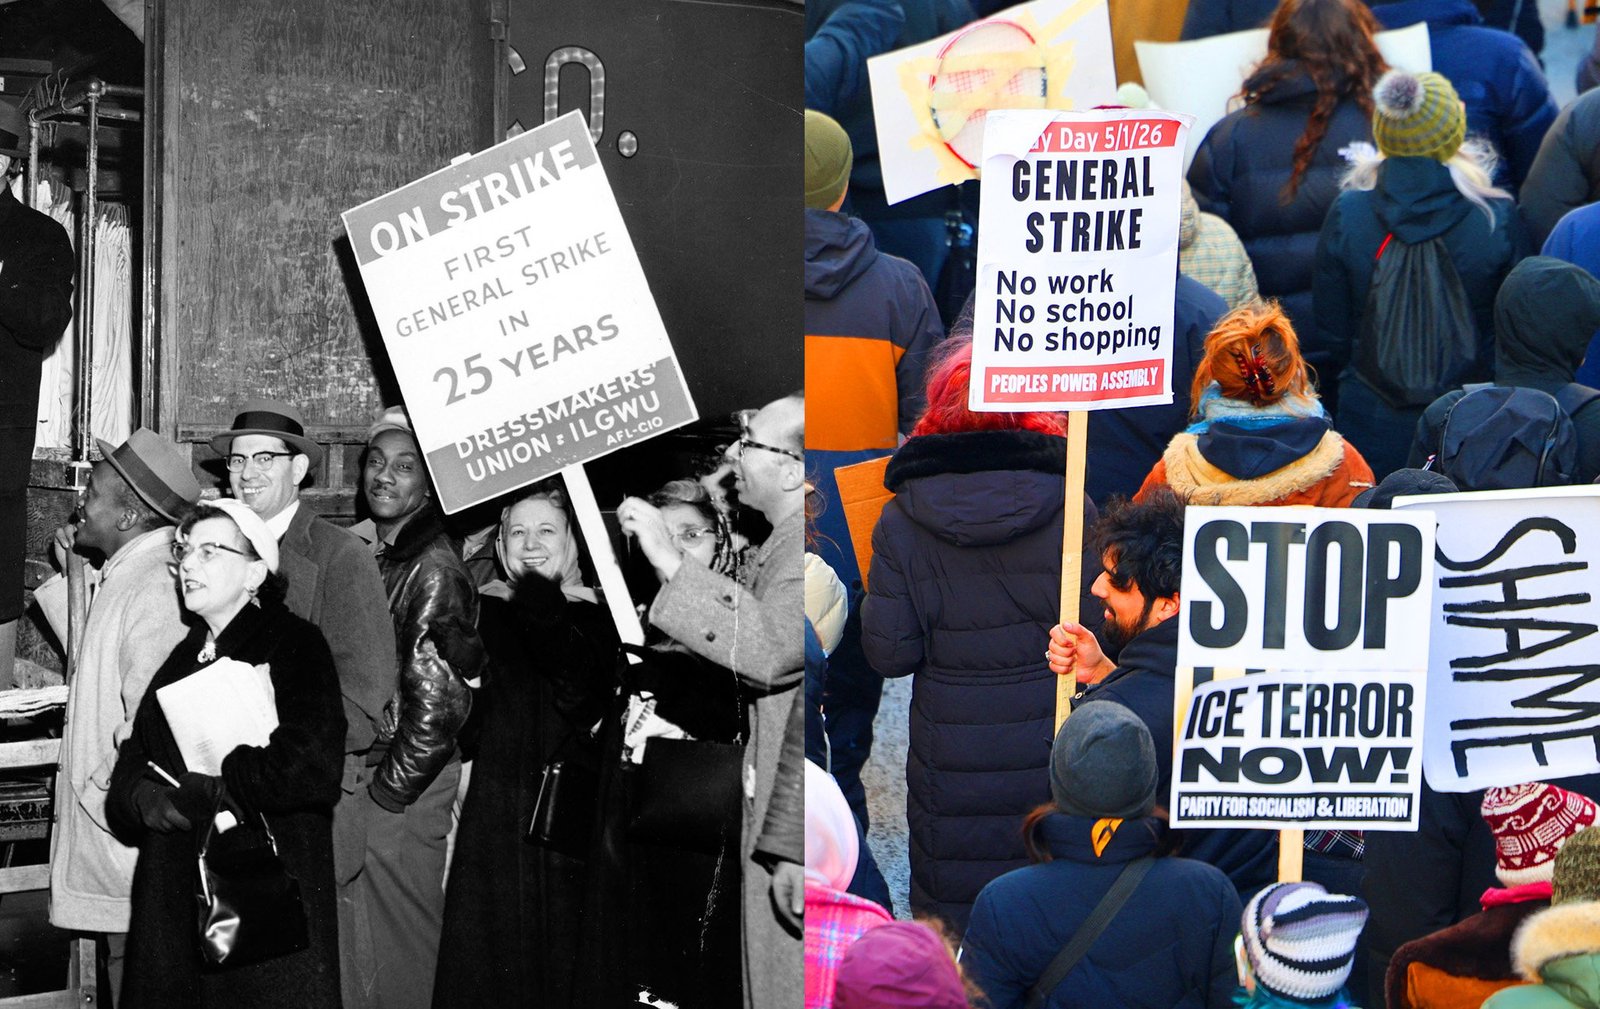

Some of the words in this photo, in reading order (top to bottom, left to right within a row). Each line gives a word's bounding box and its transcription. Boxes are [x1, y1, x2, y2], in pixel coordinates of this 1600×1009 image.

[1060, 127, 1098, 152] Day
[1104, 122, 1163, 150] 5/1/26
[369, 206, 429, 257] ON
[439, 140, 578, 228] STRIKE
[1012, 156, 1155, 202] GENERAL
[1026, 208, 1143, 253] STRIKE
[444, 226, 533, 281] FIRST
[396, 277, 513, 338] GENERAL
[521, 232, 612, 287] STRIKE
[996, 270, 1036, 296] No
[1049, 268, 1114, 294] work
[498, 310, 530, 336] IN
[996, 299, 1035, 324] No
[1046, 295, 1133, 323] school
[432, 353, 493, 406] 25
[499, 314, 620, 378] YEARS
[994, 327, 1034, 352] No
[1045, 323, 1161, 356] shopping
[991, 374, 1048, 393] PEOPLES
[1051, 373, 1098, 393] POWER
[1100, 367, 1159, 391] ASSEMBLY
[455, 361, 657, 459] DRESSMAKERS'
[606, 416, 663, 446] AFL-CIO
[466, 433, 551, 482] UNION
[569, 390, 661, 442] ILGWU
[1189, 519, 1423, 650] STOP
[1435, 516, 1600, 778] SHAME
[1185, 686, 1249, 740] ICE
[1257, 682, 1414, 739] TERROR
[1180, 746, 1414, 785] NOW!
[1180, 796, 1223, 817] PARTY
[1222, 797, 1248, 817] FOR
[1248, 796, 1316, 818] SOCIALISM
[1316, 797, 1334, 817] &
[1335, 796, 1409, 818] LIBERATION
